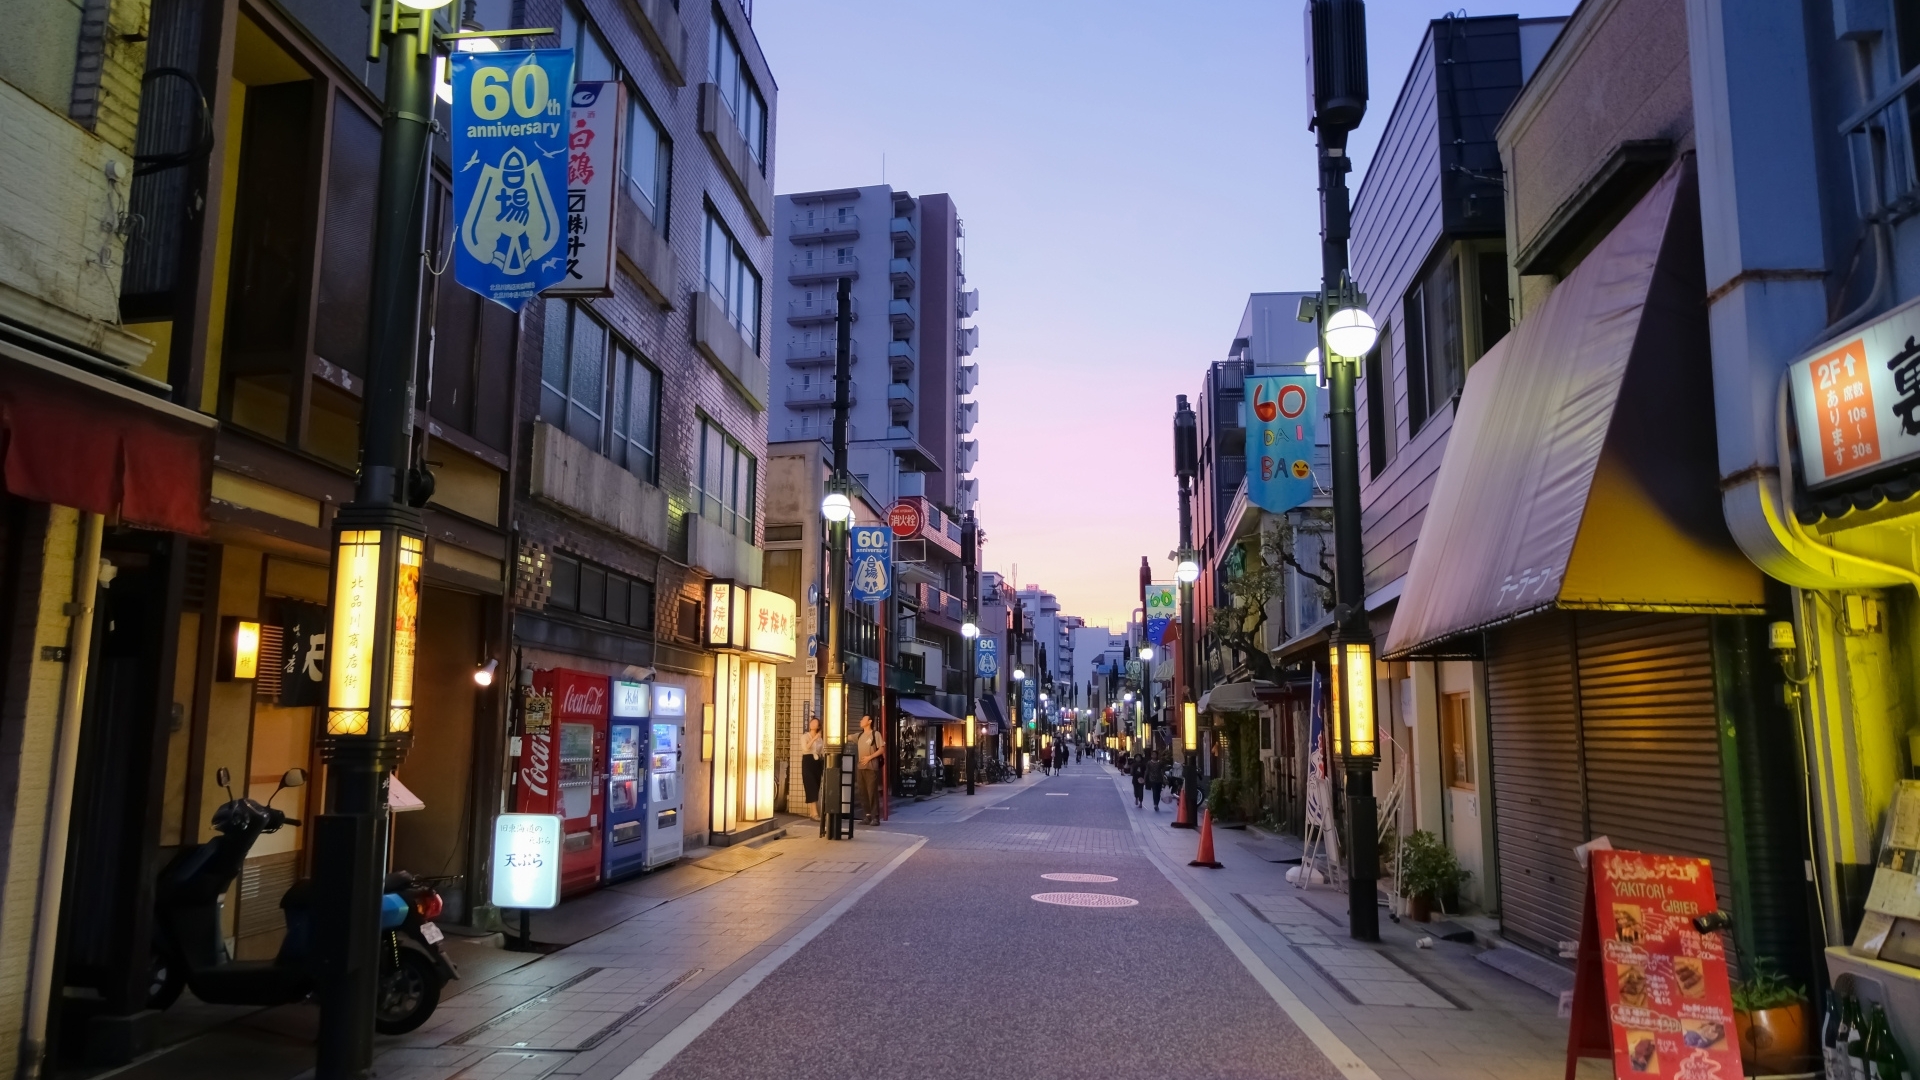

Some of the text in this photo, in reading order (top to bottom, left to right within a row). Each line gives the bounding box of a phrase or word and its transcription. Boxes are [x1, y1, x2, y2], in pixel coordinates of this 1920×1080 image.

[467, 122, 561, 139] anniversary
[1818, 358, 1841, 390] 2F
[1253, 384, 1306, 422] 60
[1827, 389, 1845, 466] あります
[891, 514, 916, 526] 消火栓
[344, 576, 364, 689] 北品川商店街
[561, 684, 604, 714] Coca-Cola
[1611, 881, 1666, 899] YAKITORI
[1661, 899, 1699, 915] GIBIER
